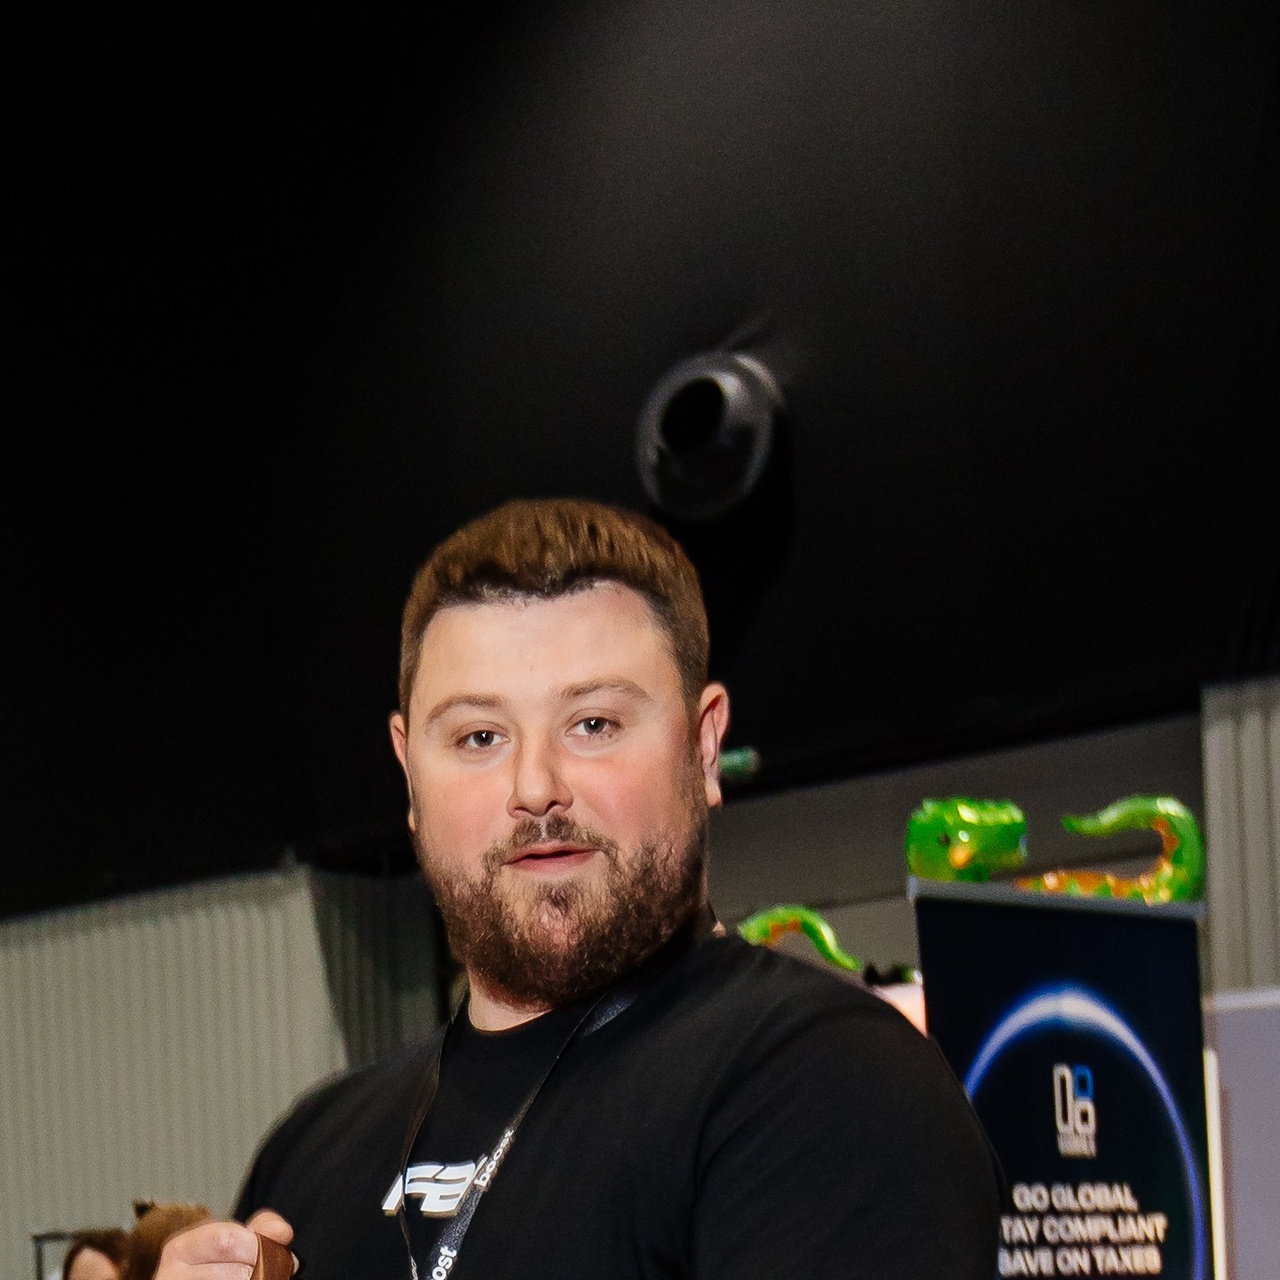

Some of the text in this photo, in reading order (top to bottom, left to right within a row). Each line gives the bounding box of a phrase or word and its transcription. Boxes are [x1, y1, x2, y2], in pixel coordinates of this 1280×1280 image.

[473, 1129, 516, 1188] boost
[999, 1214, 1040, 1245] TAY
[1056, 1246, 1091, 1276] ON
